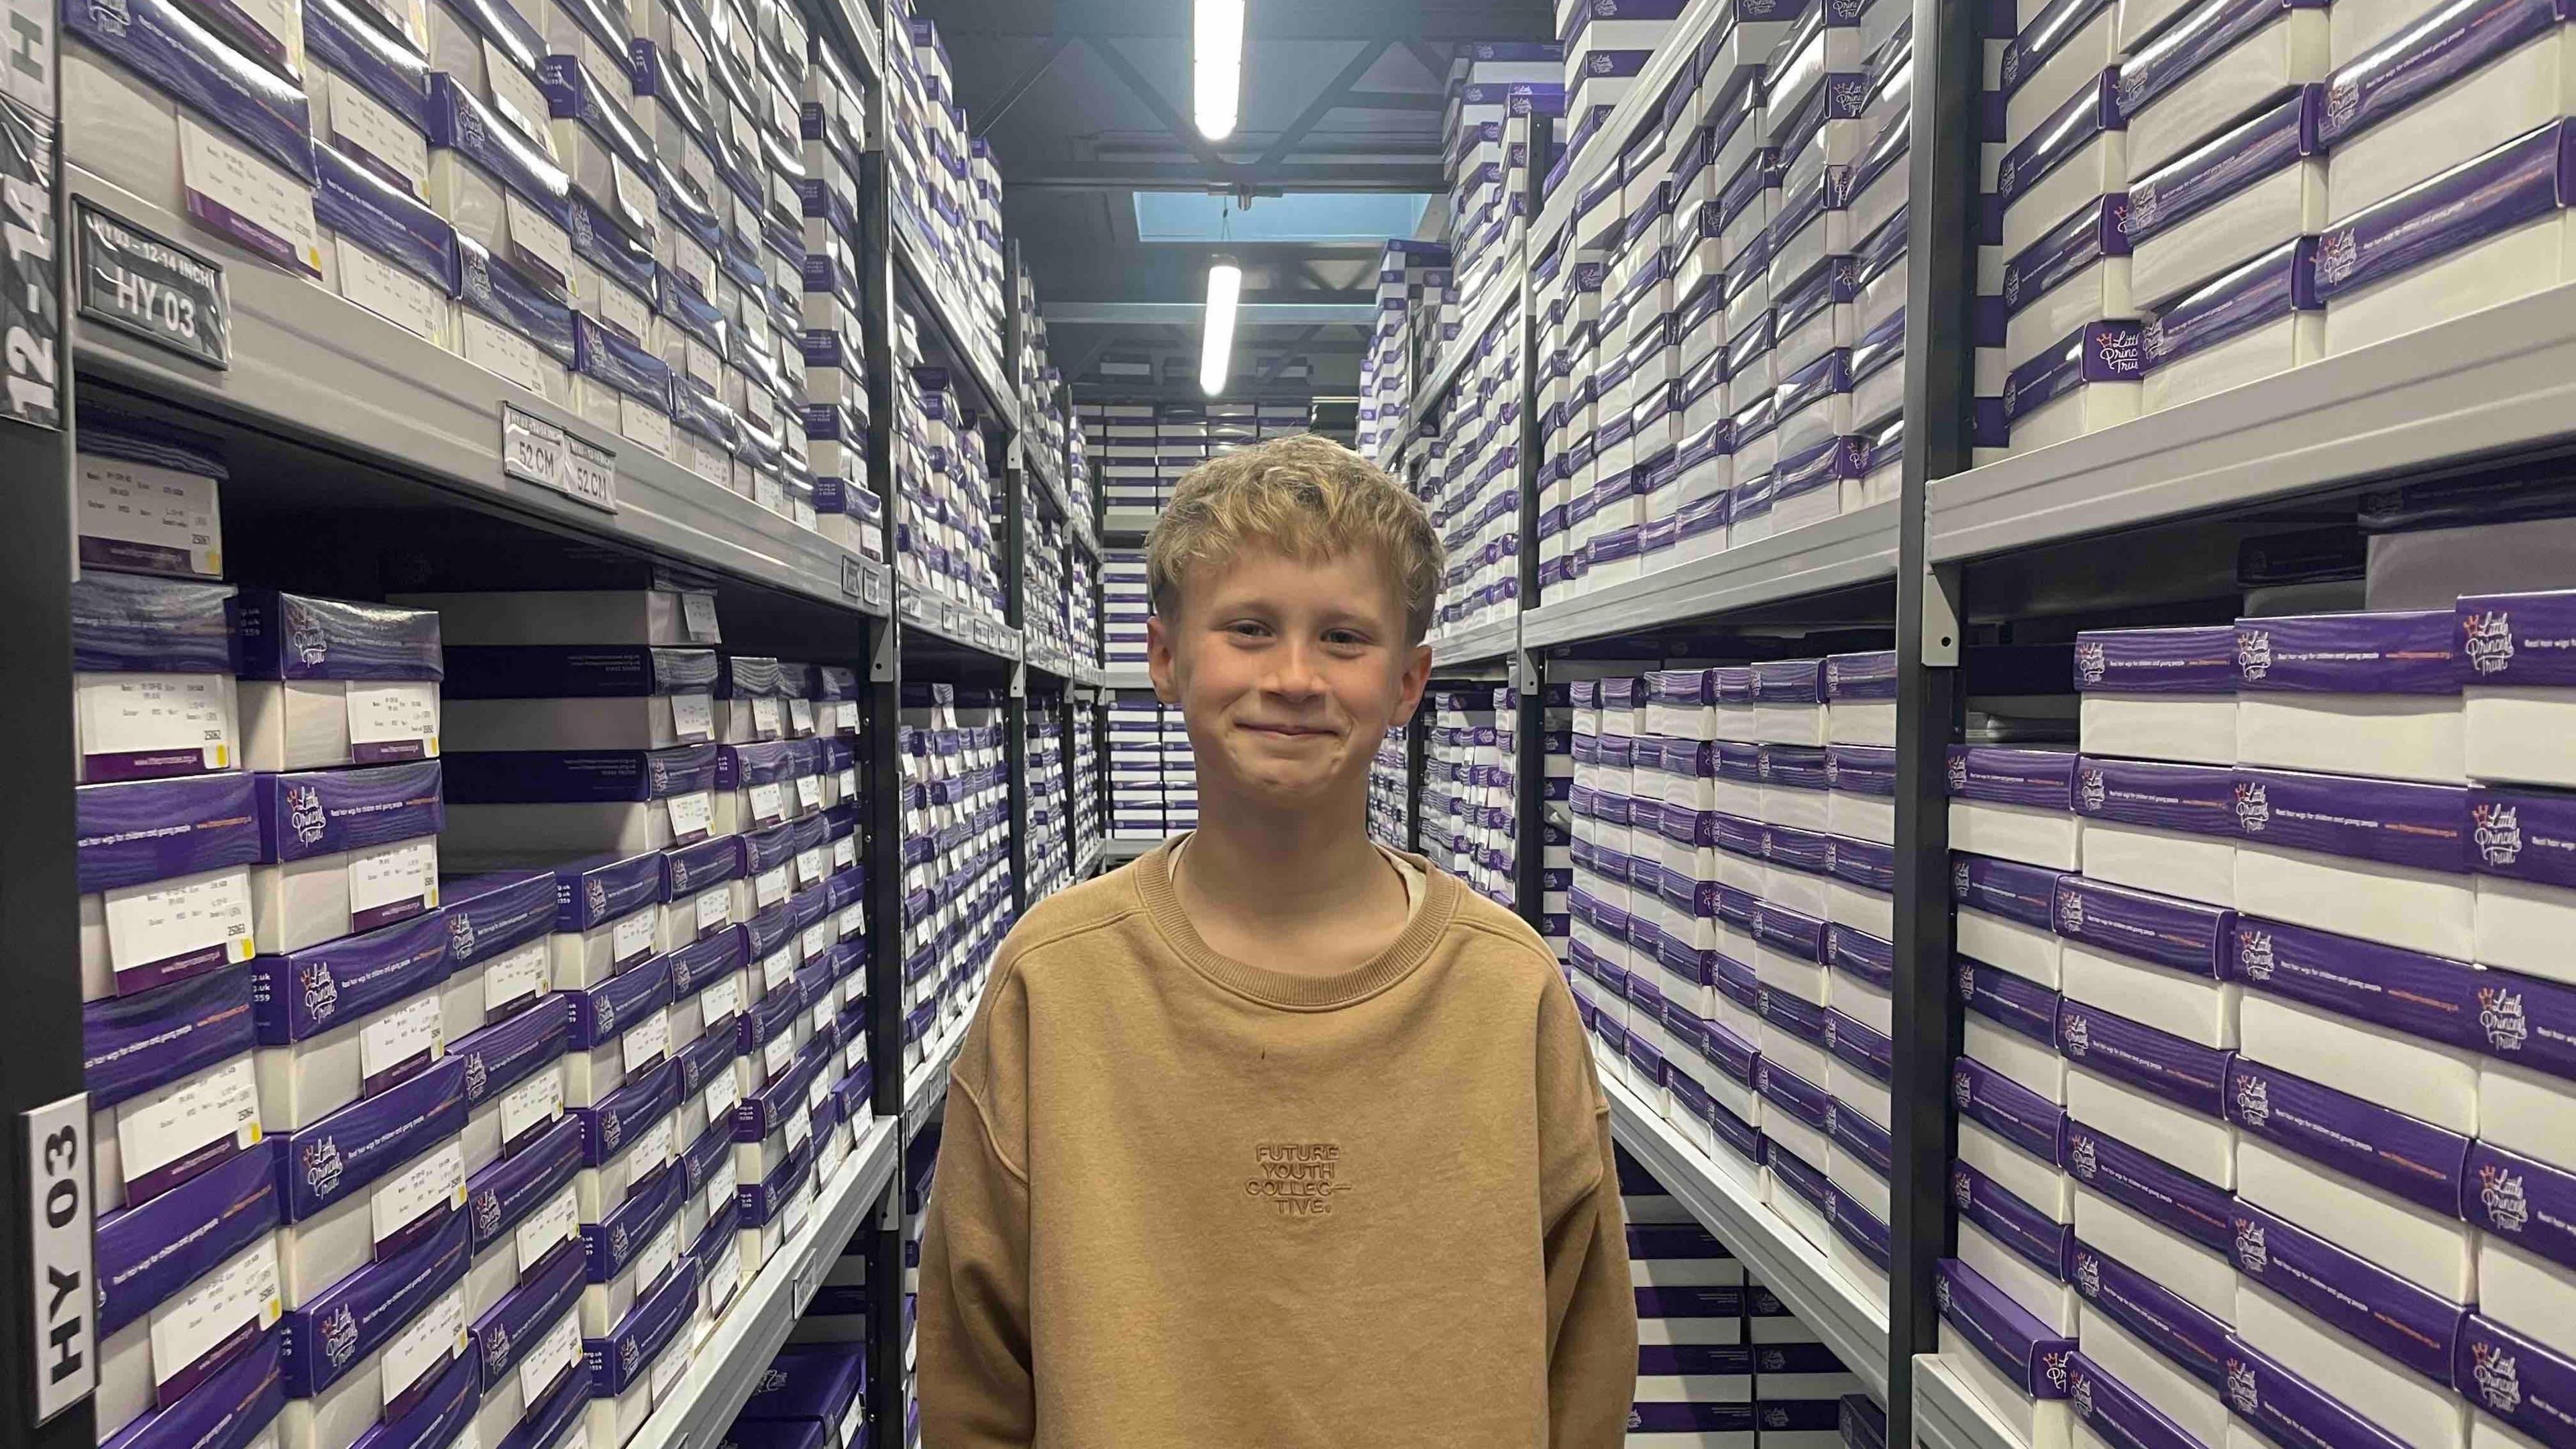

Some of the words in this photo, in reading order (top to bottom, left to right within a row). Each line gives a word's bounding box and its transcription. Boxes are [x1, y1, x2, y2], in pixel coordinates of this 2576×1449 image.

[117, 266, 158, 321] HY
[164, 291, 195, 338] 03
[2100, 347, 2139, 370] Princ
[519, 441, 533, 470] 52
[536, 447, 554, 478] CM
[578, 467, 589, 494] 52
[591, 472, 607, 500] CM
[2478, 610, 2508, 637] Little
[2466, 633, 2514, 669] Princess
[2481, 653, 2508, 678] Trust
[2487, 803, 2516, 829] Little
[2475, 827, 2522, 859] Princess
[2490, 846, 2516, 866] Trust
[2492, 988, 2522, 1017] Little
[2479, 1010, 2528, 1042] Princess
[2496, 1032, 2521, 1051] Trust
[1256, 1143, 1340, 1162] FUTURE
[44, 1124, 79, 1229] 03
[1261, 1162, 1335, 1179] YOUTH
[1274, 1197, 1332, 1215] TIVE.
[48, 1265, 82, 1386] HY
